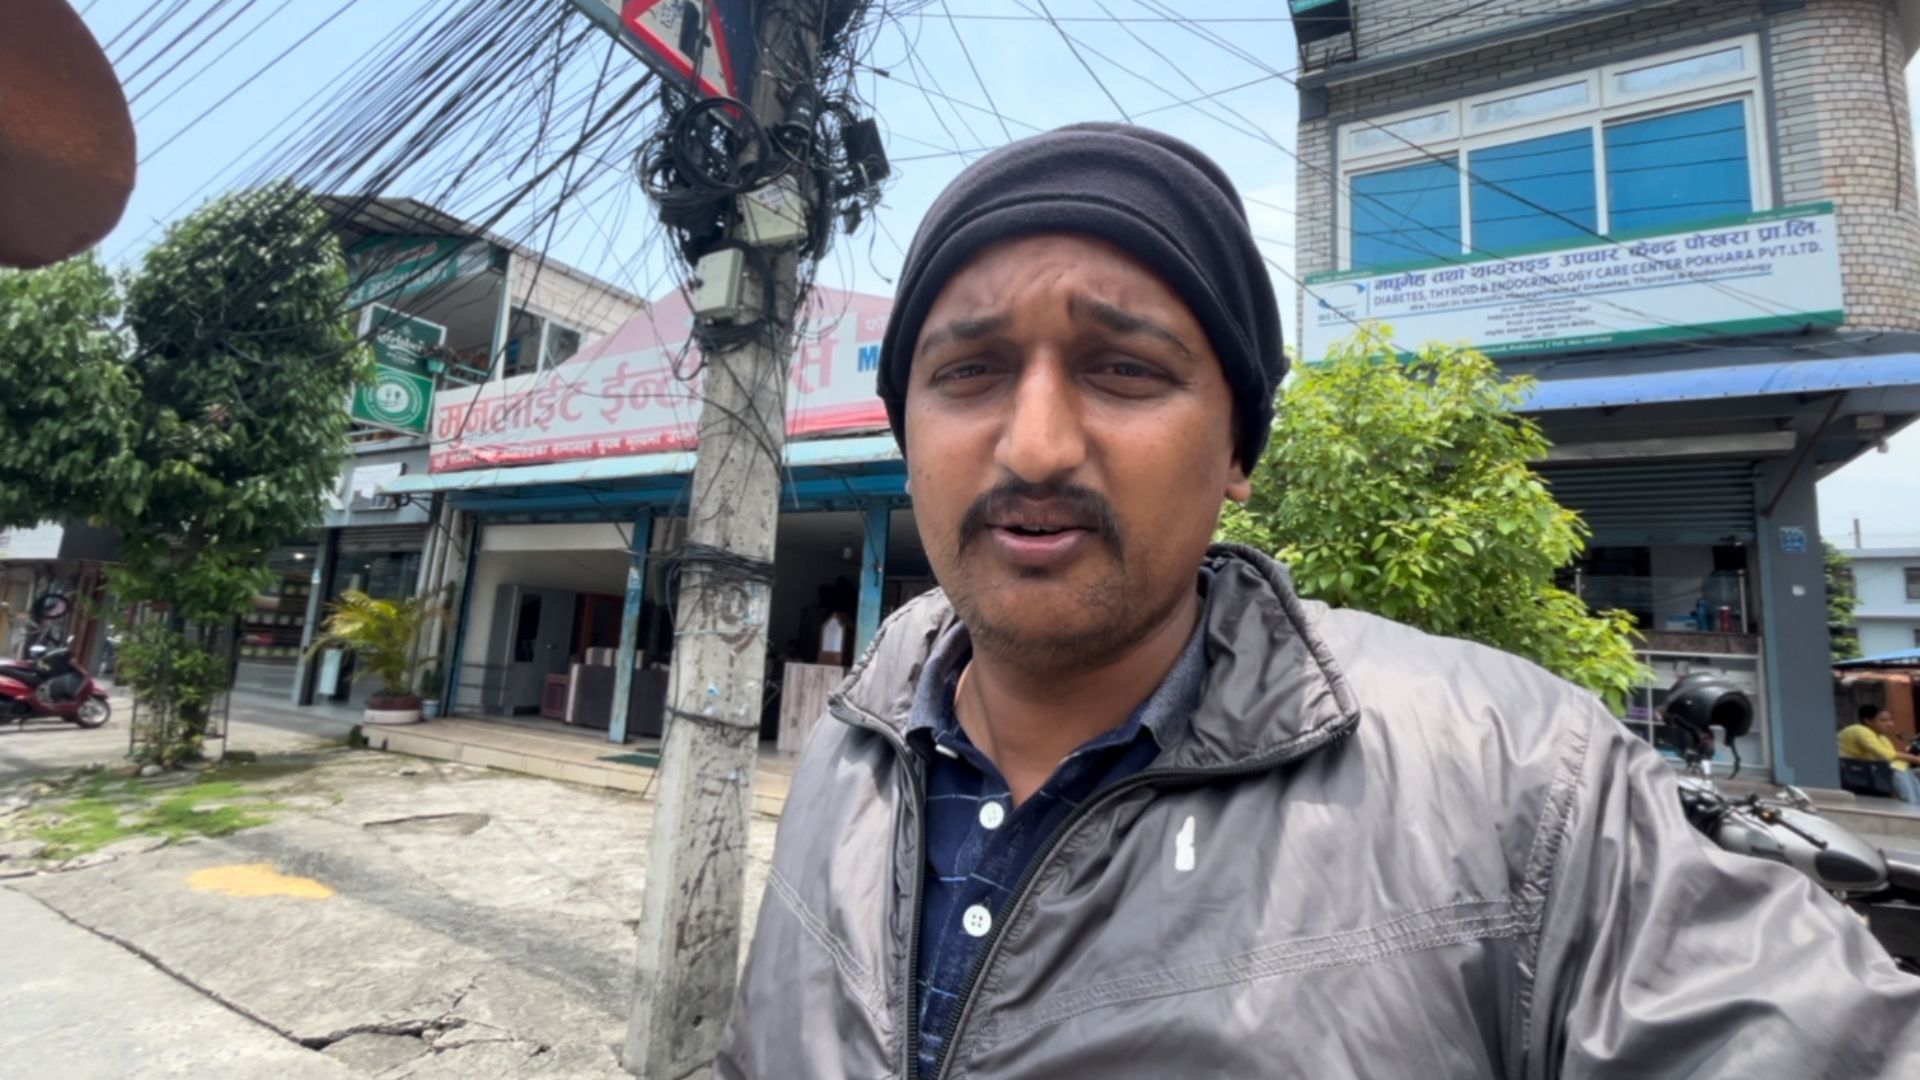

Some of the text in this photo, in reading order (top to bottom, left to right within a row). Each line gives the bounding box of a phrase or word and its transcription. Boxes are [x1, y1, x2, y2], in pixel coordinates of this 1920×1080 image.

[1375, 292, 1428, 307] DIABETES,
[1432, 285, 1480, 300] THYROID
[1493, 269, 1594, 293] ENDOCRINOLOGY
[1596, 265, 1629, 279] CARE
[1632, 259, 1683, 275] CENTER
[1687, 250, 1755, 267] POKHARA
[1433, 270, 1464, 285] तथा
[1561, 248, 1619, 267] उपचार
[1686, 232, 1749, 251] पोखरा
